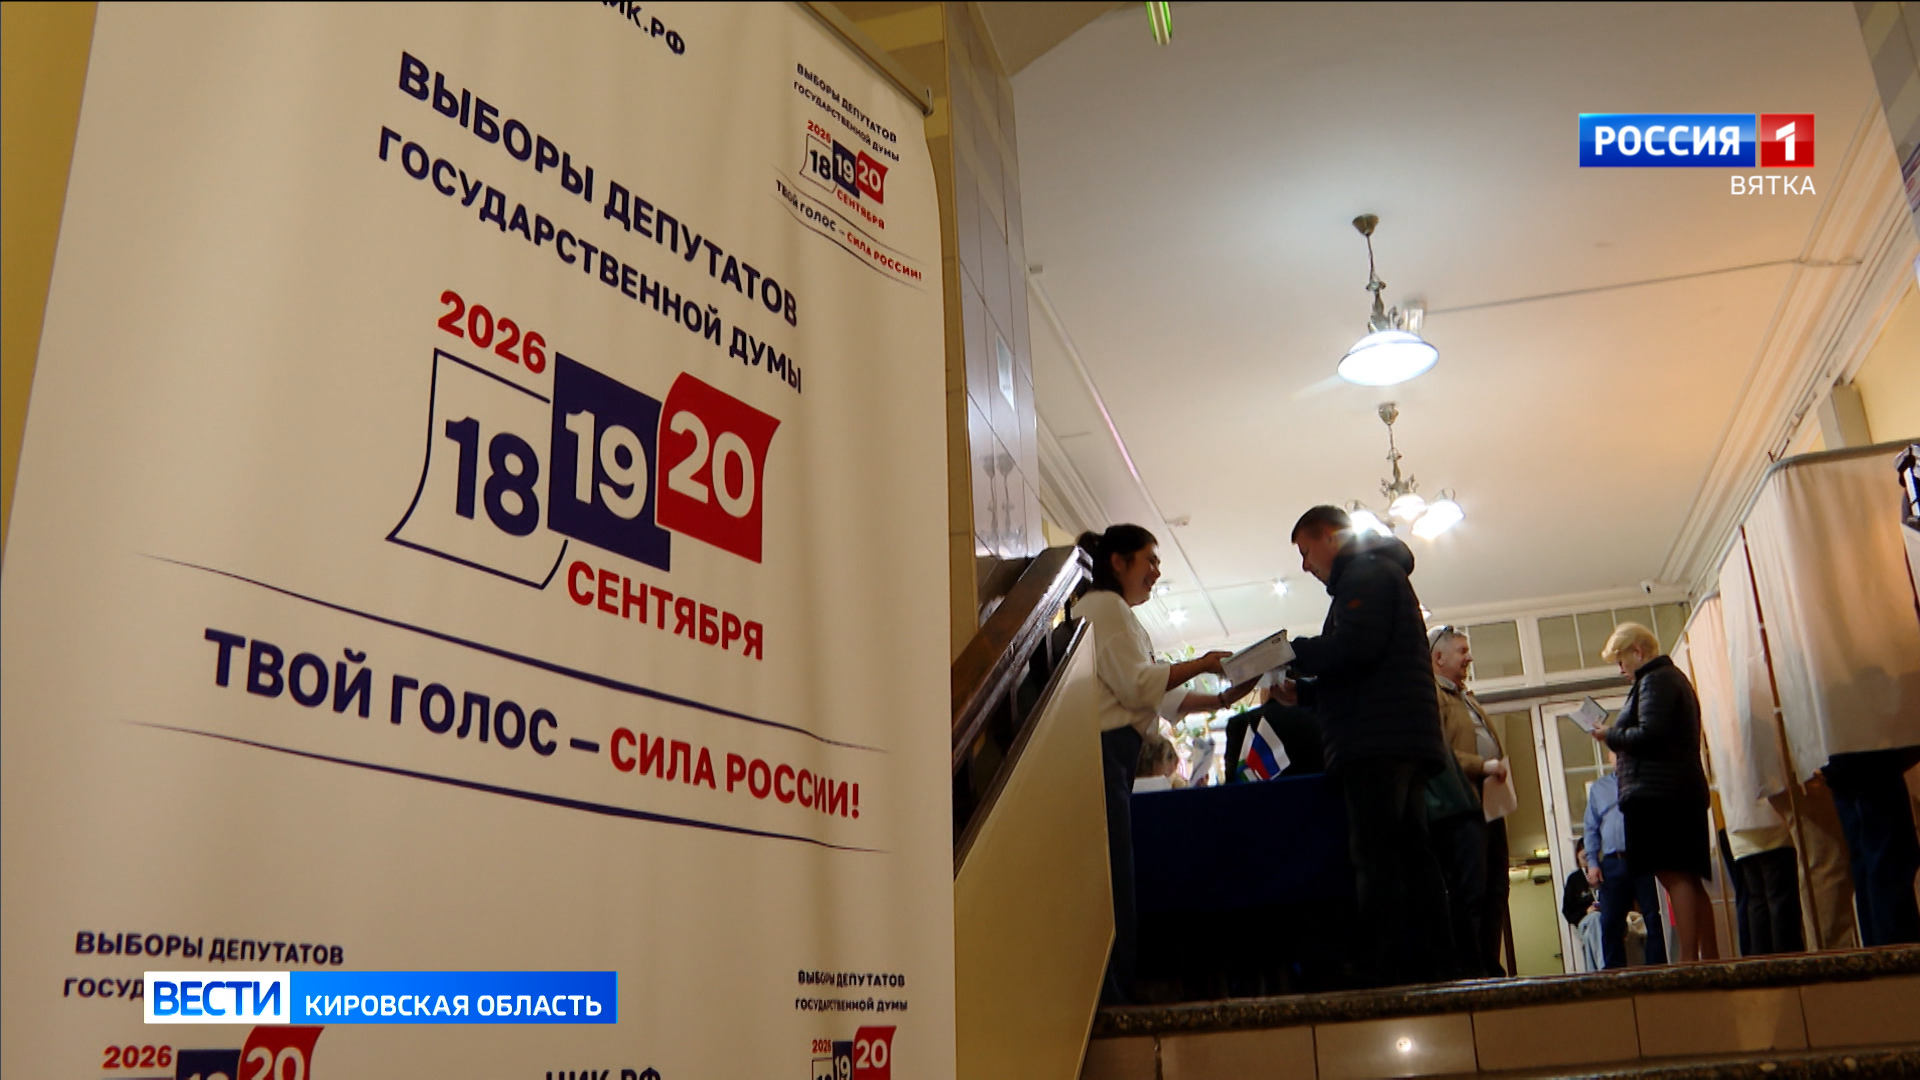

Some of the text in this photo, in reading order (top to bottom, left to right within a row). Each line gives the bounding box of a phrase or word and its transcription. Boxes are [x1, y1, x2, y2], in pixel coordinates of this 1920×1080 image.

[793, 81, 900, 162] ГОСУДАРСТВЕННОЙ ДУМЫ
[796, 63, 897, 144] ВЫБОРЫ ДЕПУТАТОВ
[807, 119, 832, 144] 2026
[399, 51, 797, 327] ВЫБОРЫ ДЕПУТАТОВ
[809, 149, 882, 188] 18 19 20
[776, 179, 799, 209] ТВОЙ
[800, 203, 837, 232] ГОЛОС
[846, 231, 872, 256] СИЛА
[873, 250, 922, 282] РОССИИ!
[836, 189, 885, 230] СЕНТЯБРЯ
[379, 126, 802, 394] ГОСУДАРСТВЕННОЙ ДУМЫ
[437, 290, 547, 374] 2026
[445, 409, 755, 537] 18 19 20
[567, 561, 764, 661] СЕНТЯБРЯ
[204, 628, 372, 719] ТВОЙ
[390, 674, 558, 756] ГОЛОС
[610, 727, 718, 790] СИЛА
[726, 752, 861, 819] РОССИИ!
[75, 931, 344, 966] ВЫБОРЫ ДЕПУТАТОВ
[798, 969, 905, 987] ВЫБОРЫ ДЕПУТАТОВ
[876, 1001, 908, 1012] ДУМЫ
[102, 1045, 172, 1069] 2026
[245, 1046, 305, 1080] 20
[855, 1039, 888, 1069] 20
